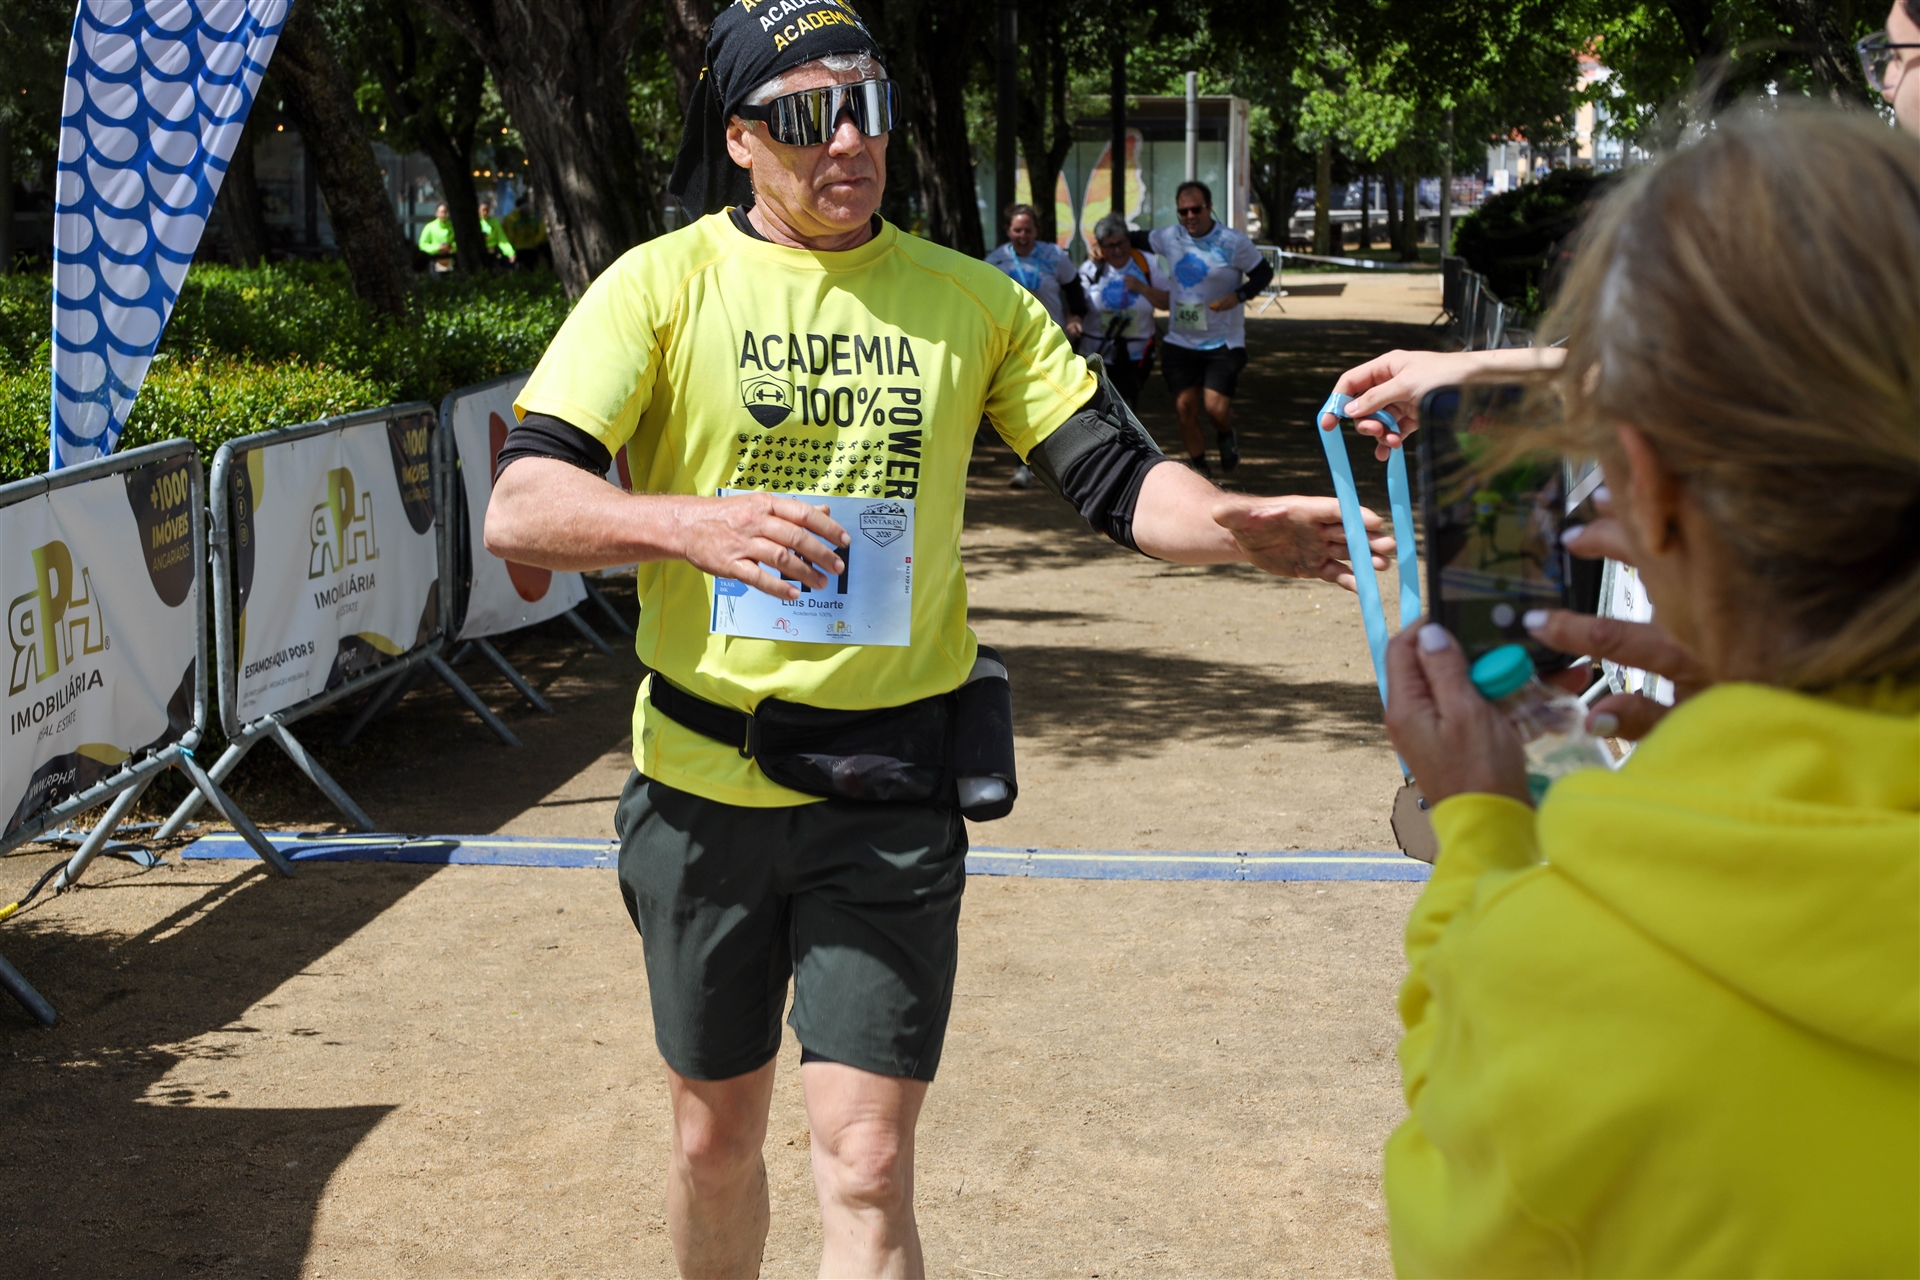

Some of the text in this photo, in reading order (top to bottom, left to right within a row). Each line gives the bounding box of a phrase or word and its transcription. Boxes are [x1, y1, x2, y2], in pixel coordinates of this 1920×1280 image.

[740, 330, 920, 377] ACADEMIA
[797, 385, 886, 428] 100%
[884, 387, 922, 499] POWER
[150, 468, 188, 511] +1000
[152, 511, 189, 549] IMÓVEIS
[808, 599, 844, 610] Duarte
[289, 643, 308, 660] POR
[11, 669, 104, 735] IMOBILIÁRIA
[56, 709, 77, 733] ESTATE
